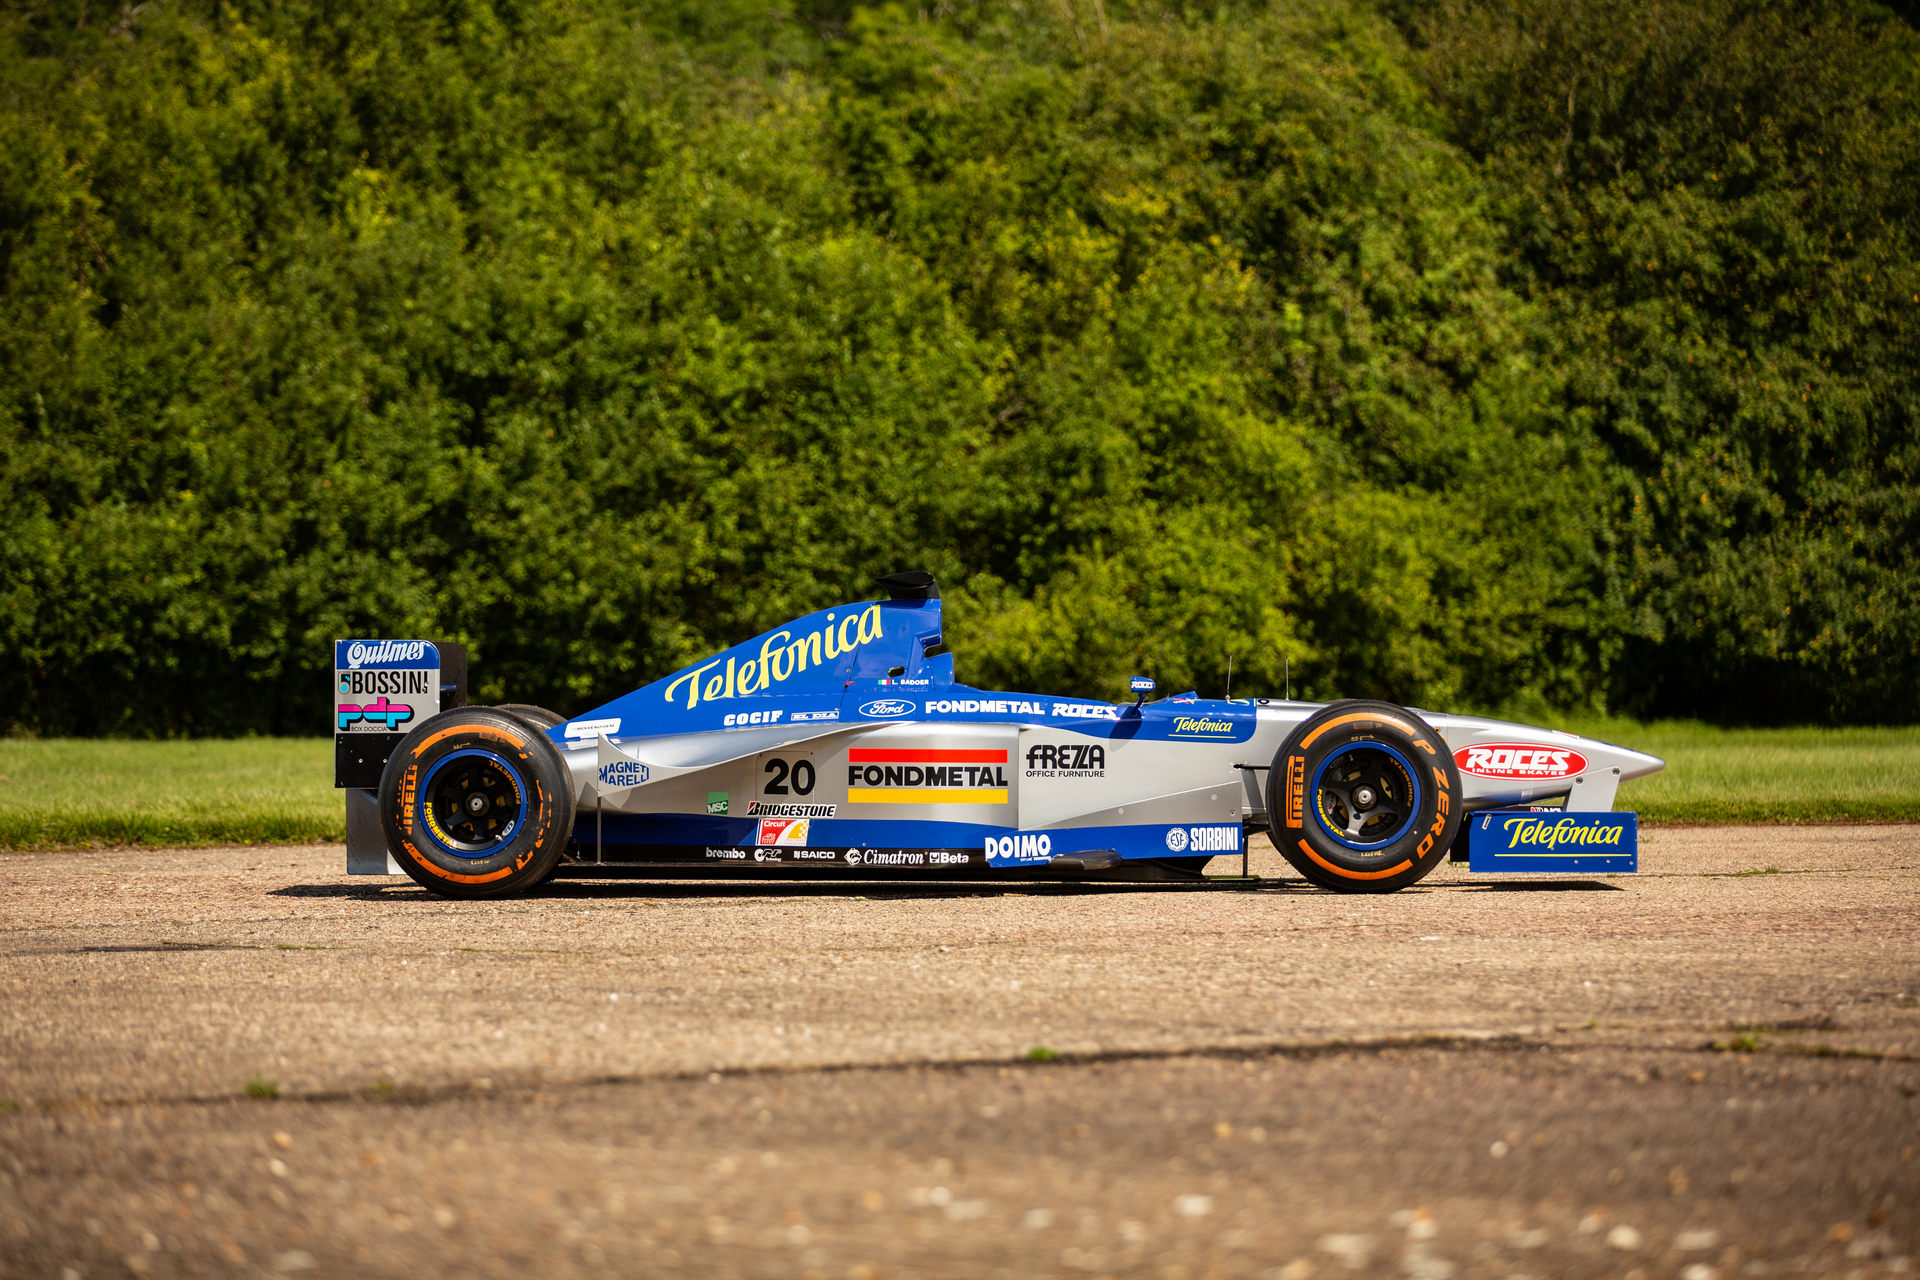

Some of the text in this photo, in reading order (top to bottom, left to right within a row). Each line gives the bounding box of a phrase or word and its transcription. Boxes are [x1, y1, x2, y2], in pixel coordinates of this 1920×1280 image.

[347, 640, 425, 669] Quilmes
[869, 702, 904, 714] Ford
[925, 700, 1045, 714] FONDMETAL
[723, 710, 783, 726] COCIF
[599, 761, 649, 776] MAGNETI
[848, 765, 1008, 787] FONDMETAL
[599, 774, 649, 786] MARELLI
[764, 758, 816, 796] 20
[1412, 739, 1450, 859] P ZERO
[707, 801, 729, 813] MSC
[747, 802, 836, 817] BRIDGESTONE
[985, 834, 1051, 859] DOIMO
[1190, 827, 1238, 851] SORBINI
[706, 846, 746, 859] brembo
[801, 850, 836, 859] SAICO
[864, 850, 924, 864] Cimatron
[941, 852, 969, 863] Beta
